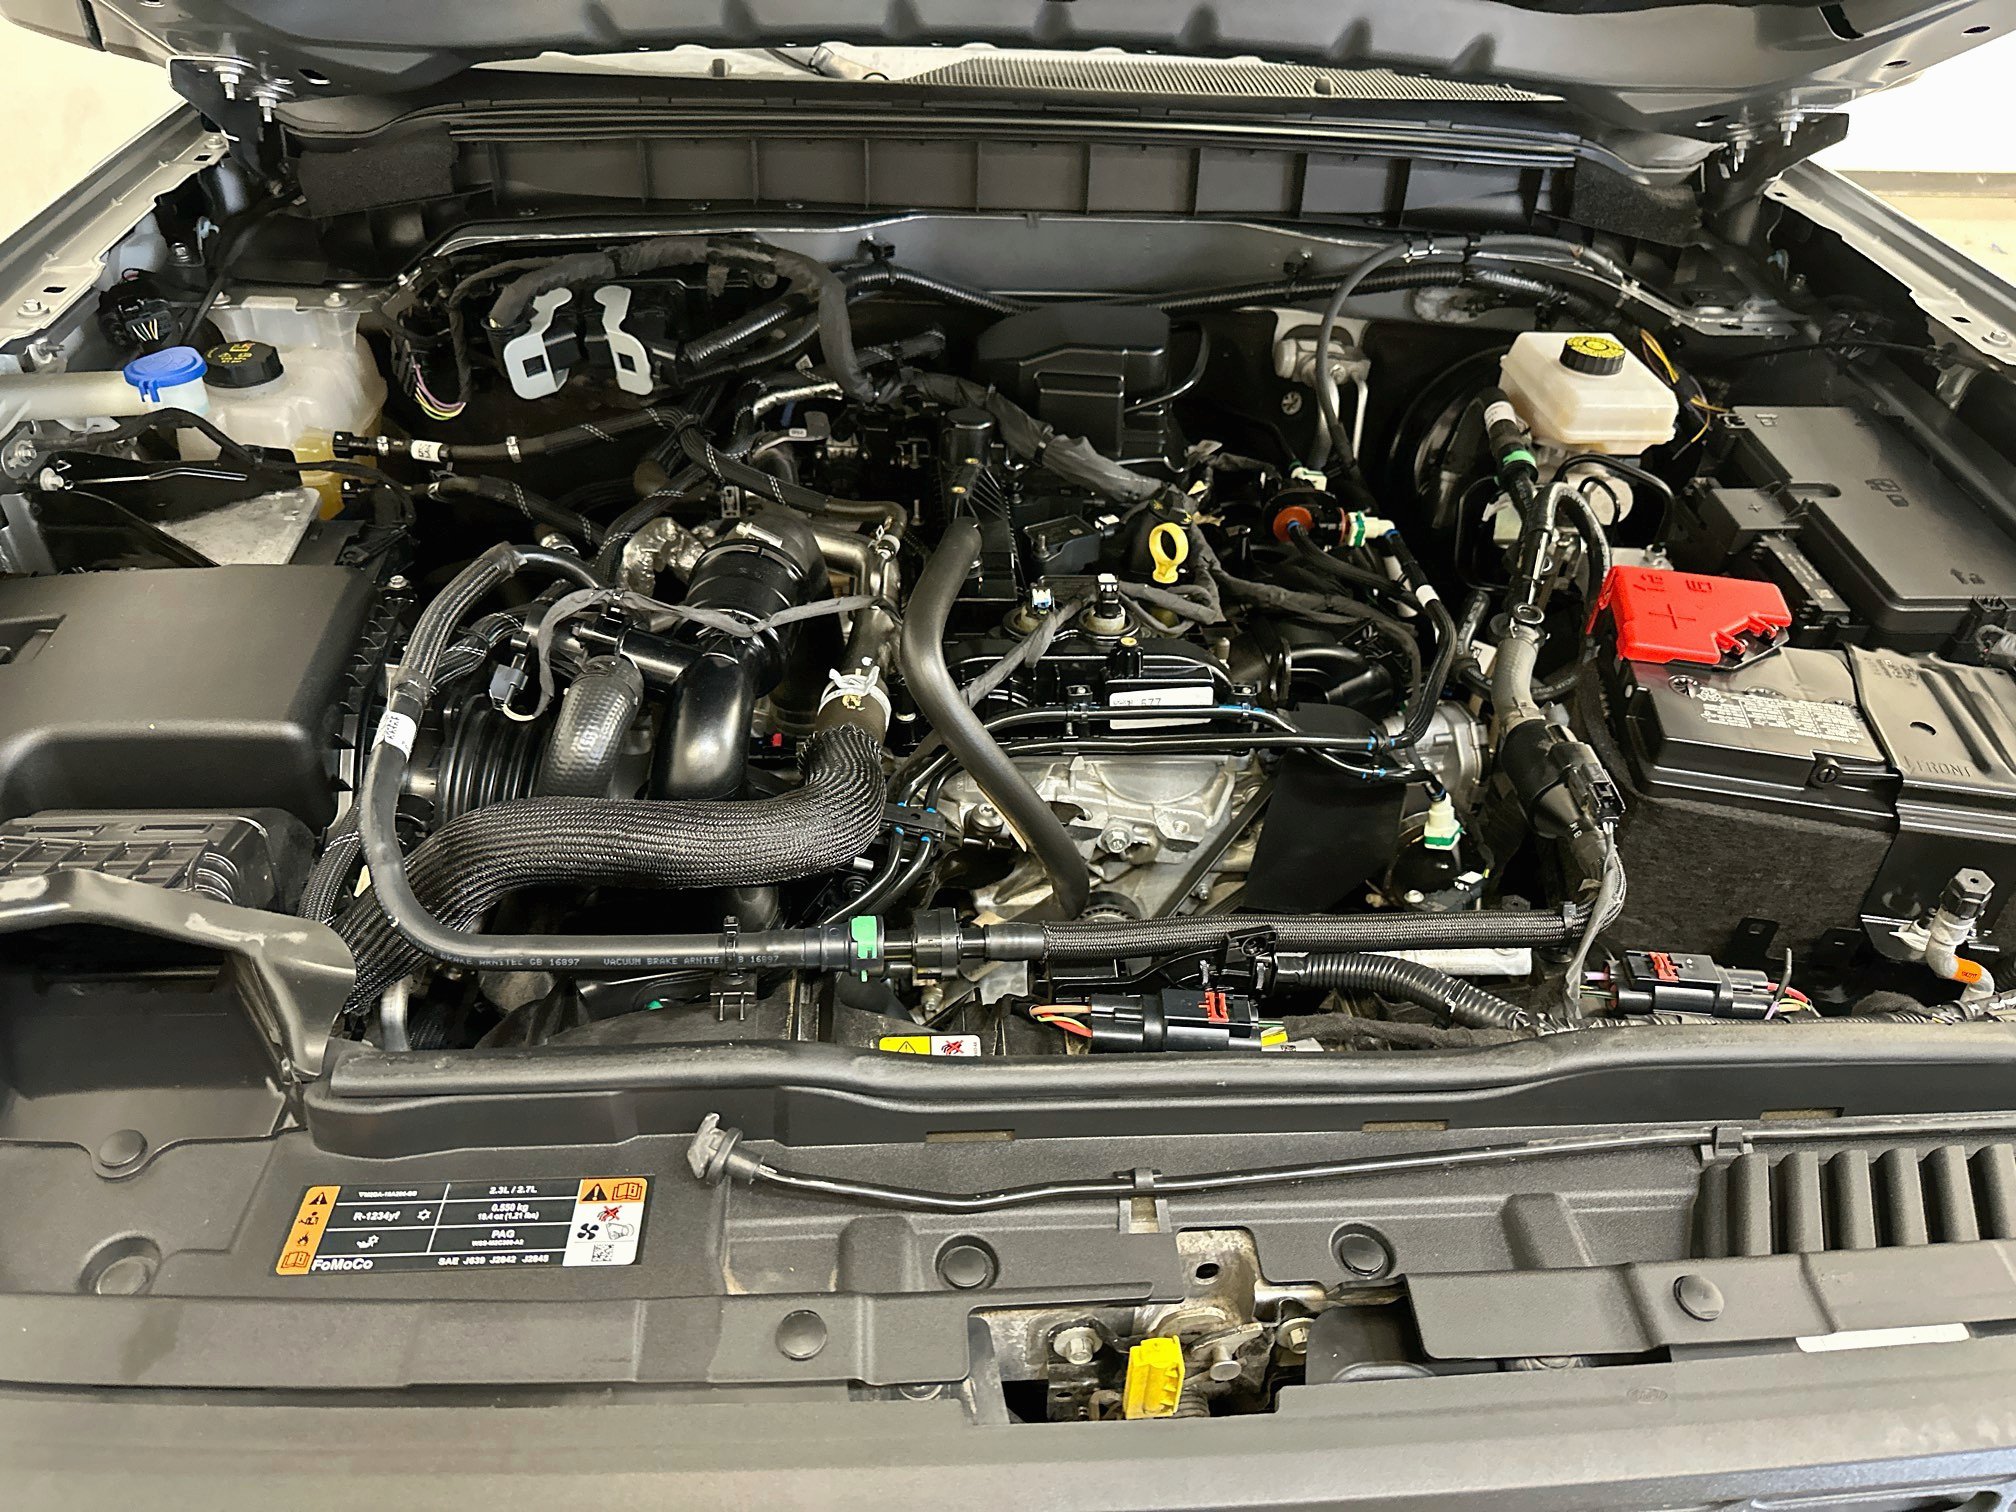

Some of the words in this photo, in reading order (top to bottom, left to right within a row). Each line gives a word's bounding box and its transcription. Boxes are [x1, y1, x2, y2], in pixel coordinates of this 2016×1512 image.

[529, 958, 543, 967] GB
[549, 957, 581, 967] 16897
[603, 957, 642, 967] VACUUM
[646, 956, 679, 966] BRAKE
[683, 956, 723, 965] ARNITE
[749, 954, 780, 964] 16897
[488, 1185, 510, 1195] 2.3L
[516, 1184, 538, 1194] 2.7L
[516, 1202, 530, 1213] kg
[352, 1209, 401, 1223] R-1234yf
[490, 1229, 516, 1239] PAG
[310, 1257, 374, 1272] FoMoCo
[437, 1256, 460, 1266] SAE
